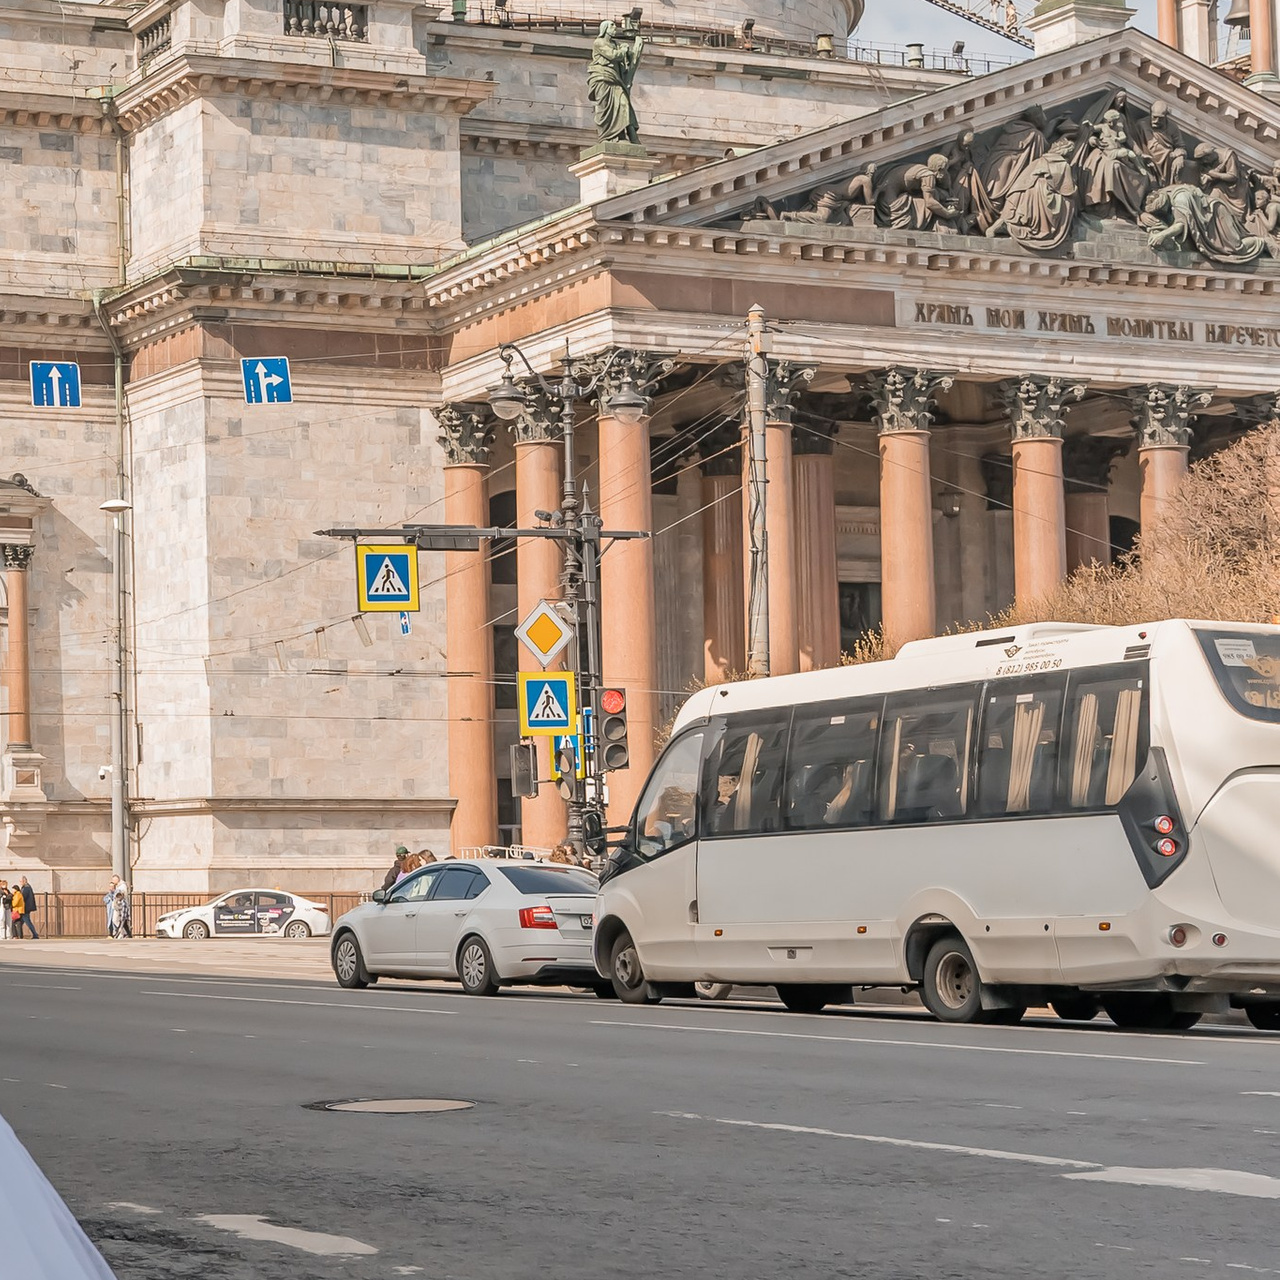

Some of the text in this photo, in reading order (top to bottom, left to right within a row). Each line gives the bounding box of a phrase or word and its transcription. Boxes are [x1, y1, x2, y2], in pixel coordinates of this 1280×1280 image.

[914, 303, 974, 326] ХРАМЪ
[1037, 311, 1096, 334] ХРАМЪ
[1106, 316, 1194, 342] МОЛИТВЫ
[996, 658, 1062, 675] 8 (812) 985 00 50
